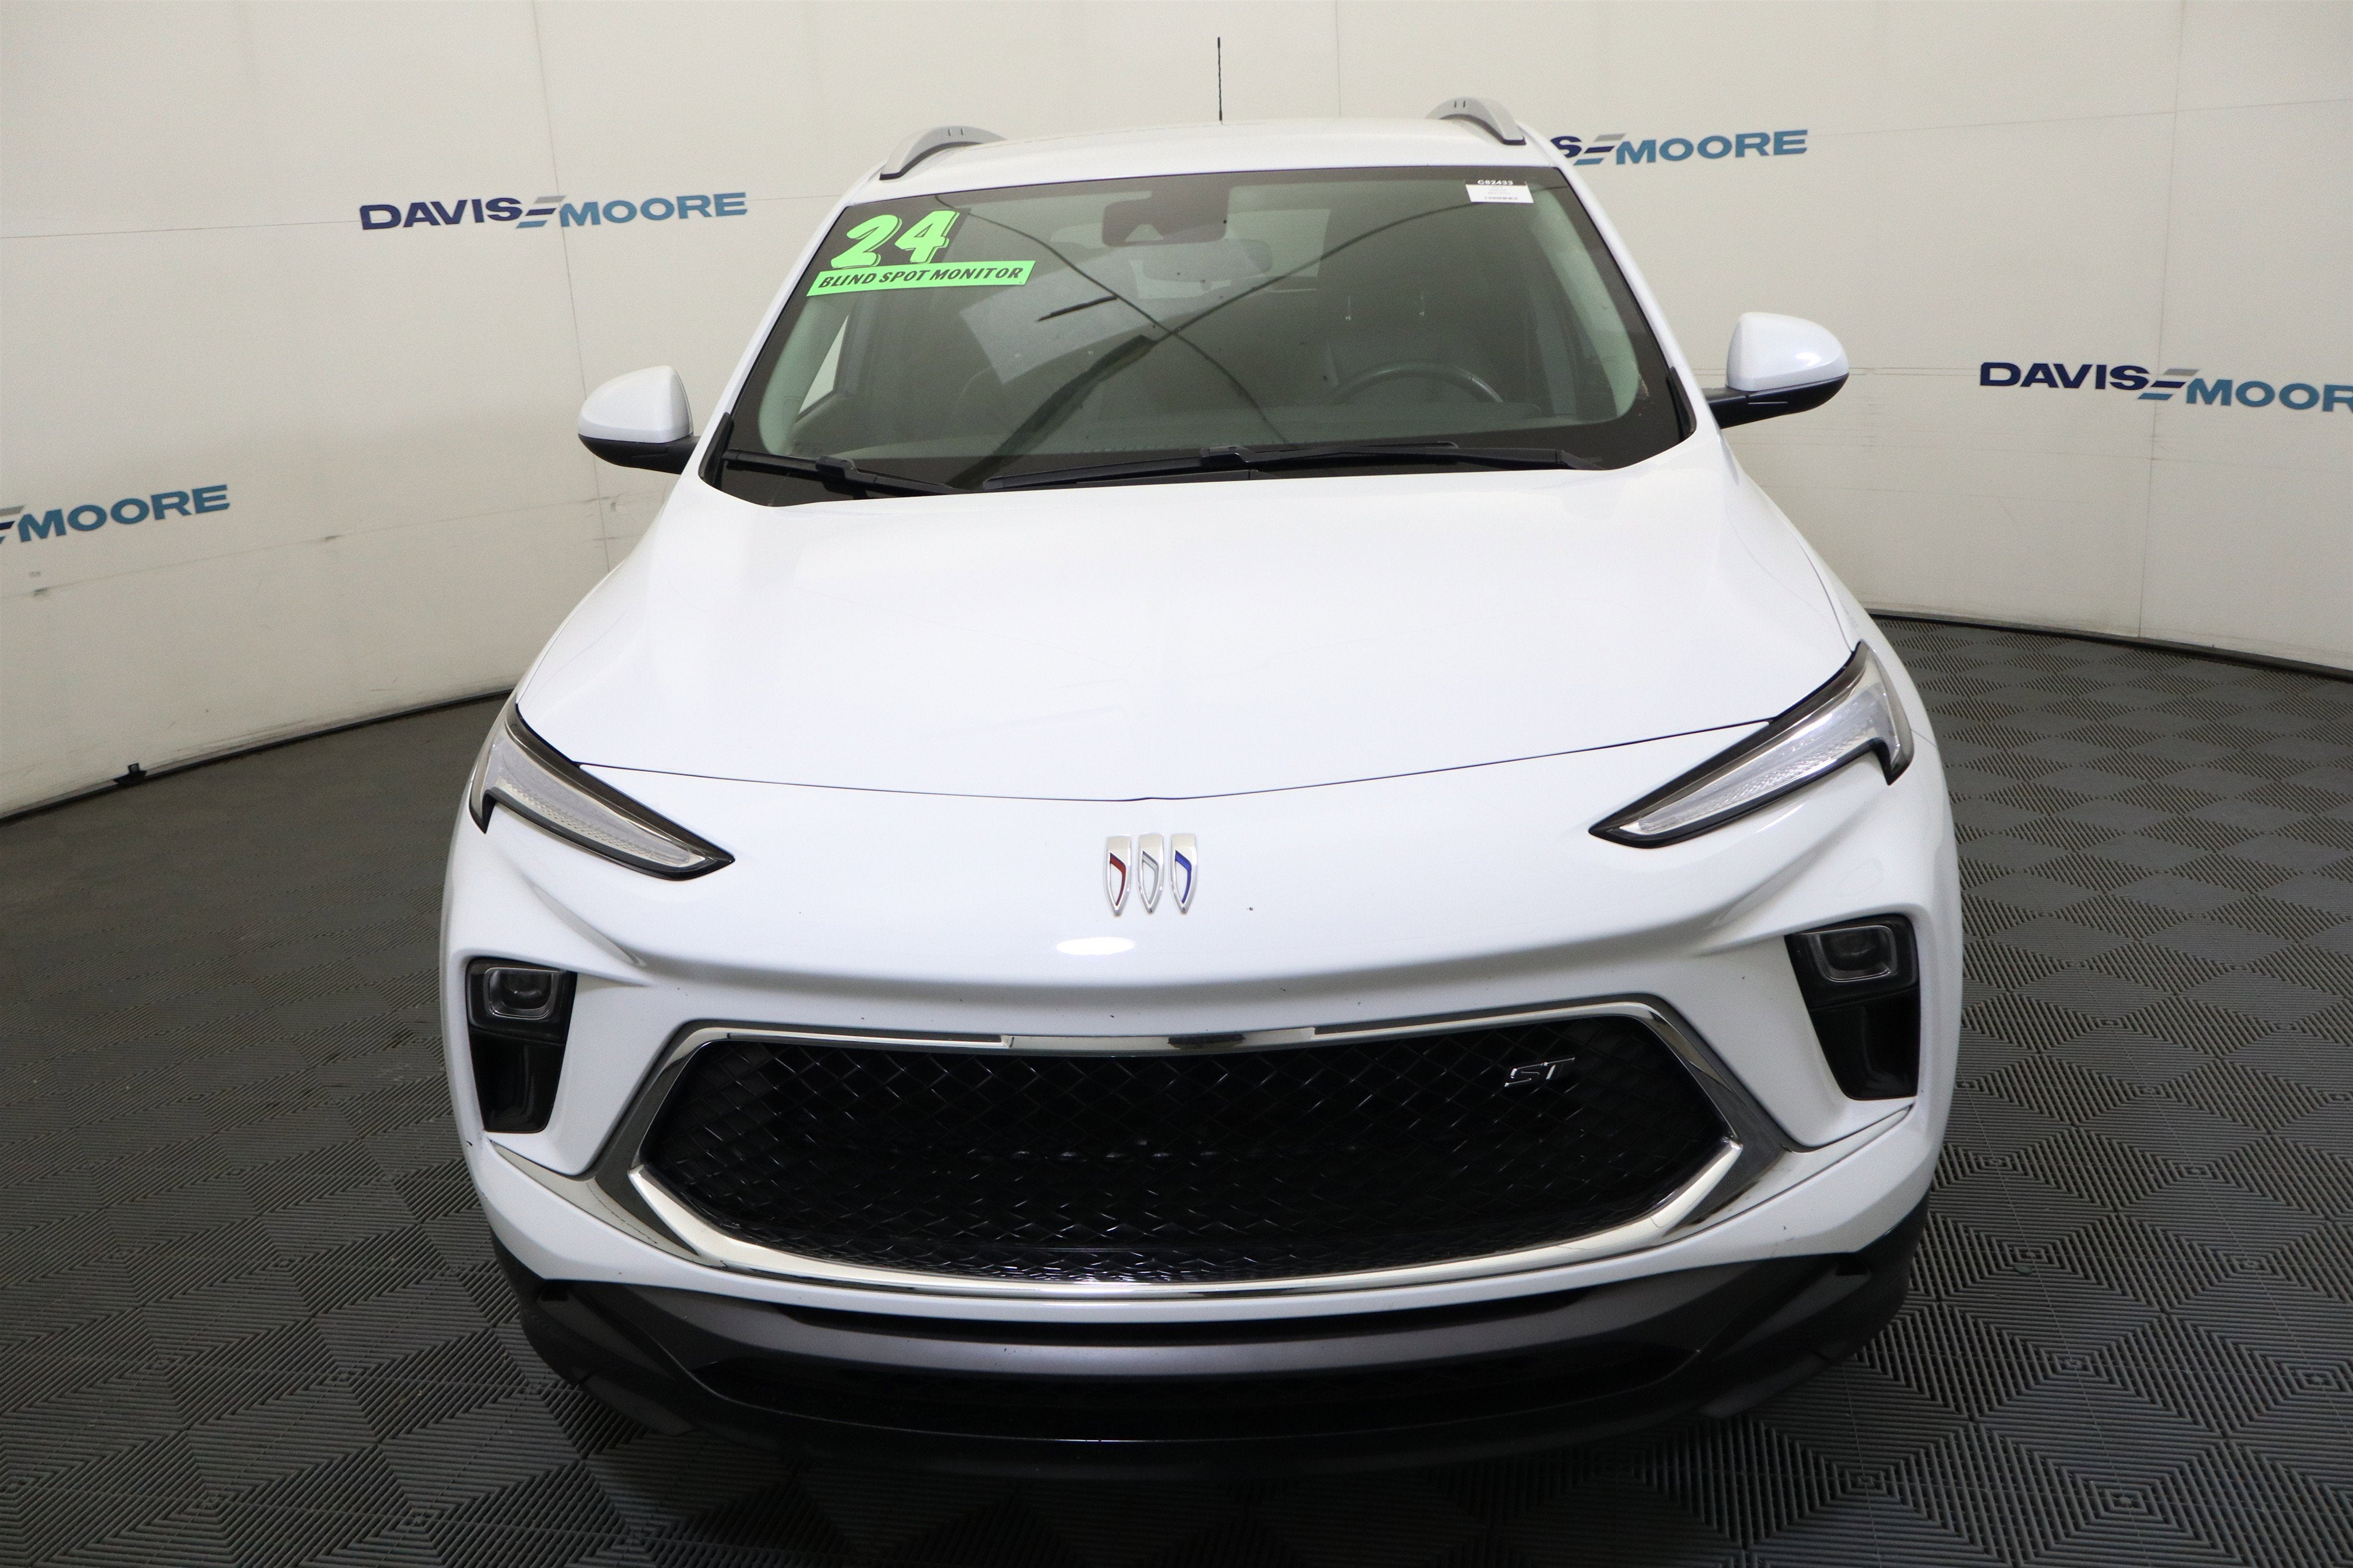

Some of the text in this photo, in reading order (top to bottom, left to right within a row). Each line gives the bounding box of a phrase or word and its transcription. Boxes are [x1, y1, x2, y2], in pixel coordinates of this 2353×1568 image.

[1615, 129, 1808, 165] MOORE
[360, 192, 748, 230] DAVIS MOORE
[830, 210, 960, 269] 24
[818, 267, 1024, 288] BLIND SPOT MONITOR
[1980, 362, 2353, 412] DAVIS MOOR
[17, 484, 230, 543] MOORE
[1504, 1057, 1576, 1087] ST
